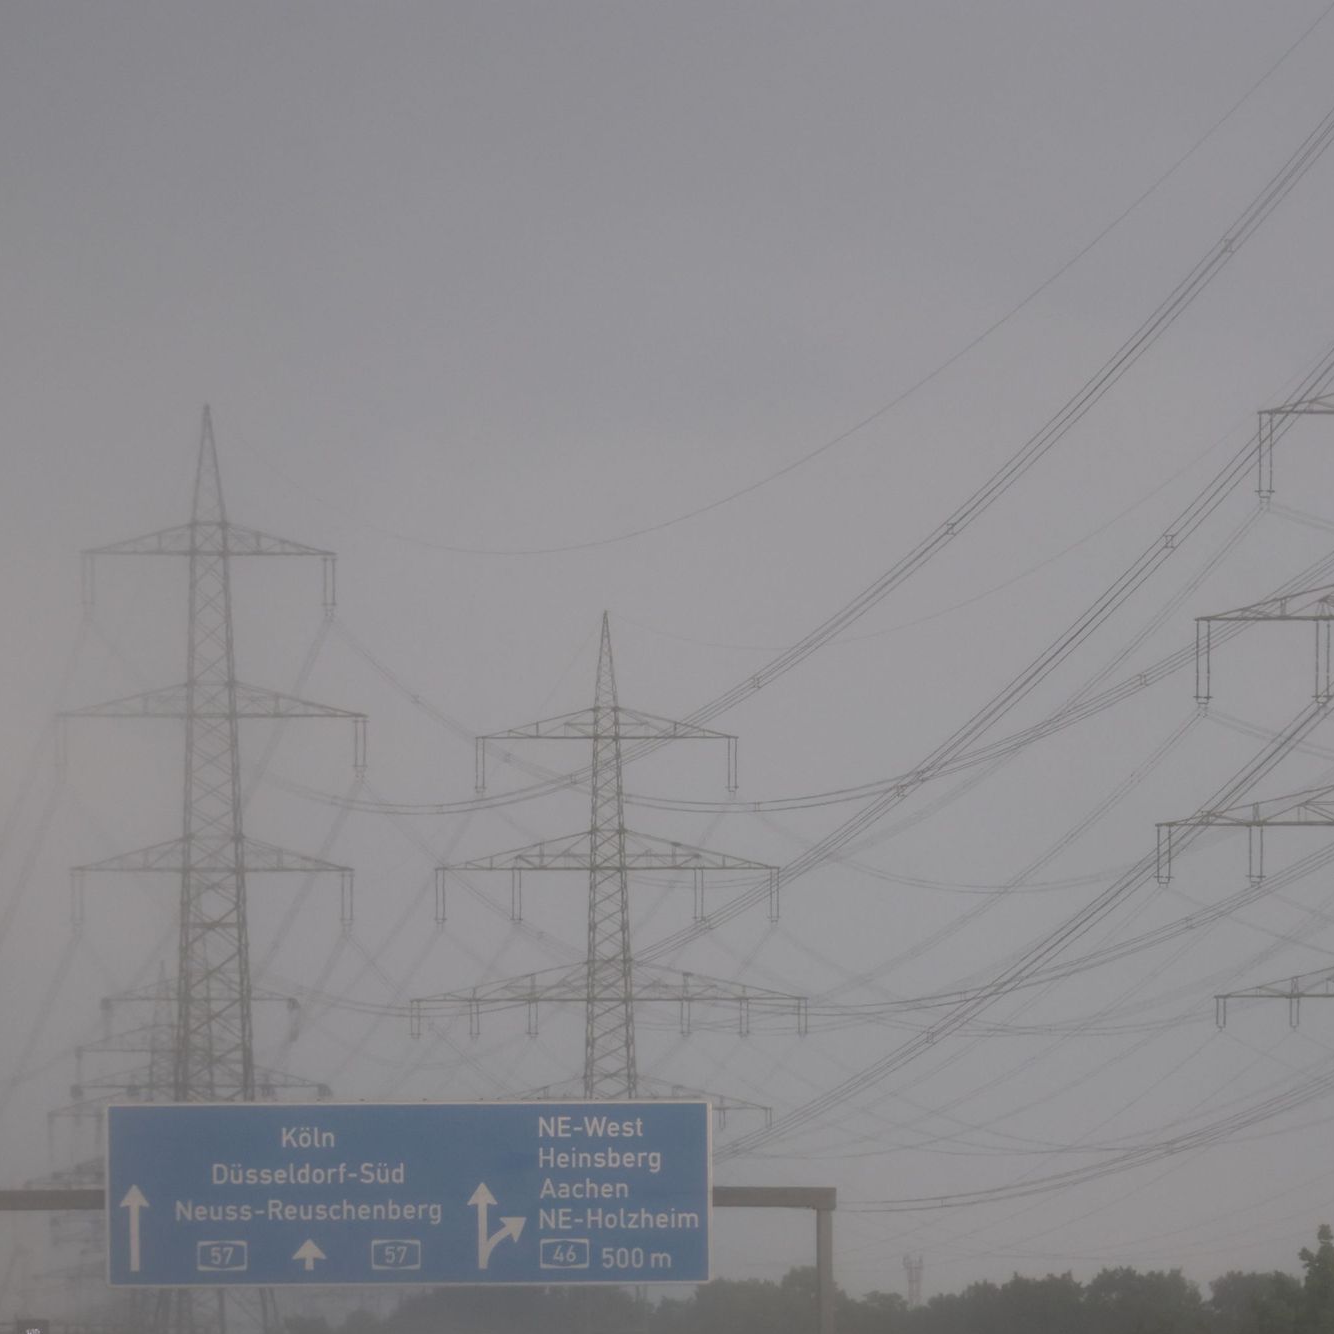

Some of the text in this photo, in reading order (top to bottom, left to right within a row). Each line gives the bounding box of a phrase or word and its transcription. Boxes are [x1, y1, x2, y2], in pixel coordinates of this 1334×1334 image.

[281, 1125, 336, 1149] Köln
[538, 1113, 644, 1139] NE-West
[538, 1146, 662, 1175] Heinsberg
[211, 1161, 405, 1185] Düsseldorf-Süd
[539, 1177, 630, 1200] Aachen
[174, 1198, 443, 1226] Neuss-Reuschenberg
[538, 1207, 701, 1231] NE-Holzheim
[210, 1246, 235, 1266] 57
[384, 1245, 408, 1265] 57
[552, 1244, 577, 1264] 46
[601, 1247, 672, 1269] 500 m
